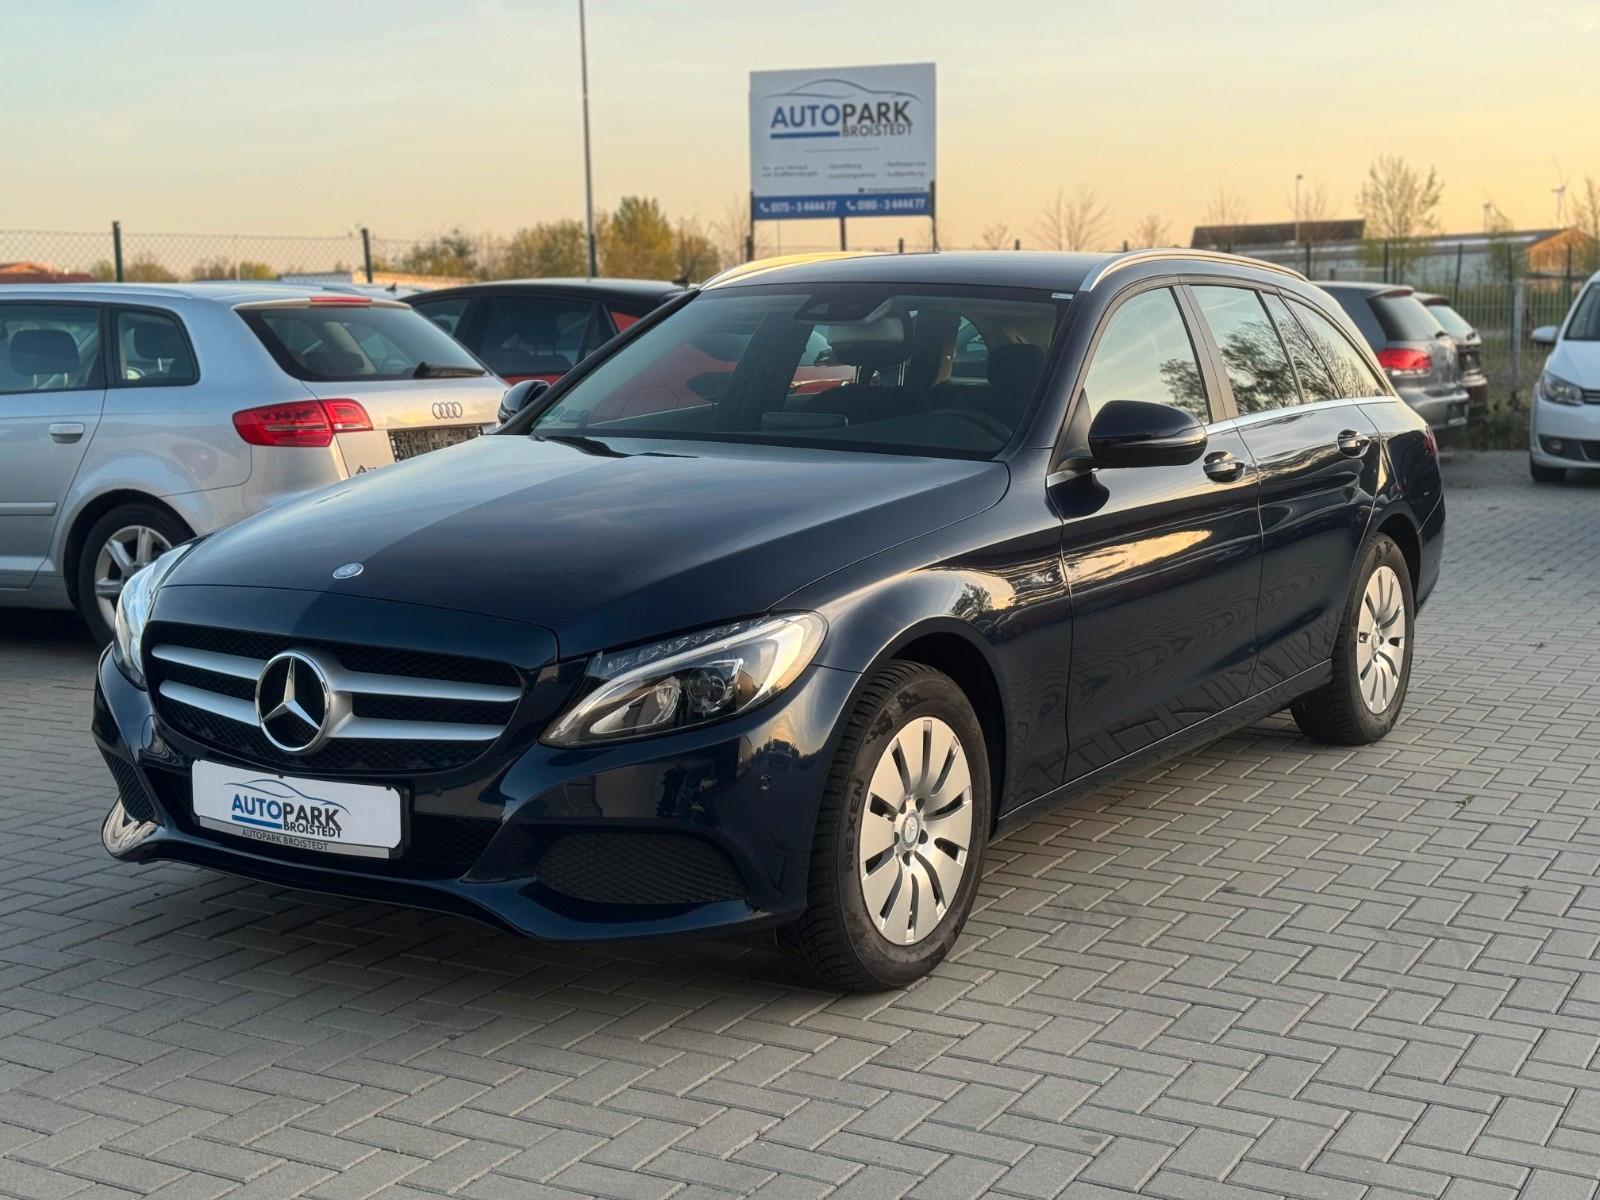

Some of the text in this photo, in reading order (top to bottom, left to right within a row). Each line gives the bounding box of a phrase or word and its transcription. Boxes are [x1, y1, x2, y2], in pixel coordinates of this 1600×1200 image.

[770, 101, 912, 129] AUTOPARK
[842, 123, 913, 138] BROISTEDT
[231, 793, 342, 831] AUTOPARK
[846, 779, 864, 870] NEXEN
[242, 828, 329, 851] AUTOPARK BROISTEDT
[283, 821, 342, 838] BROISTEDT
